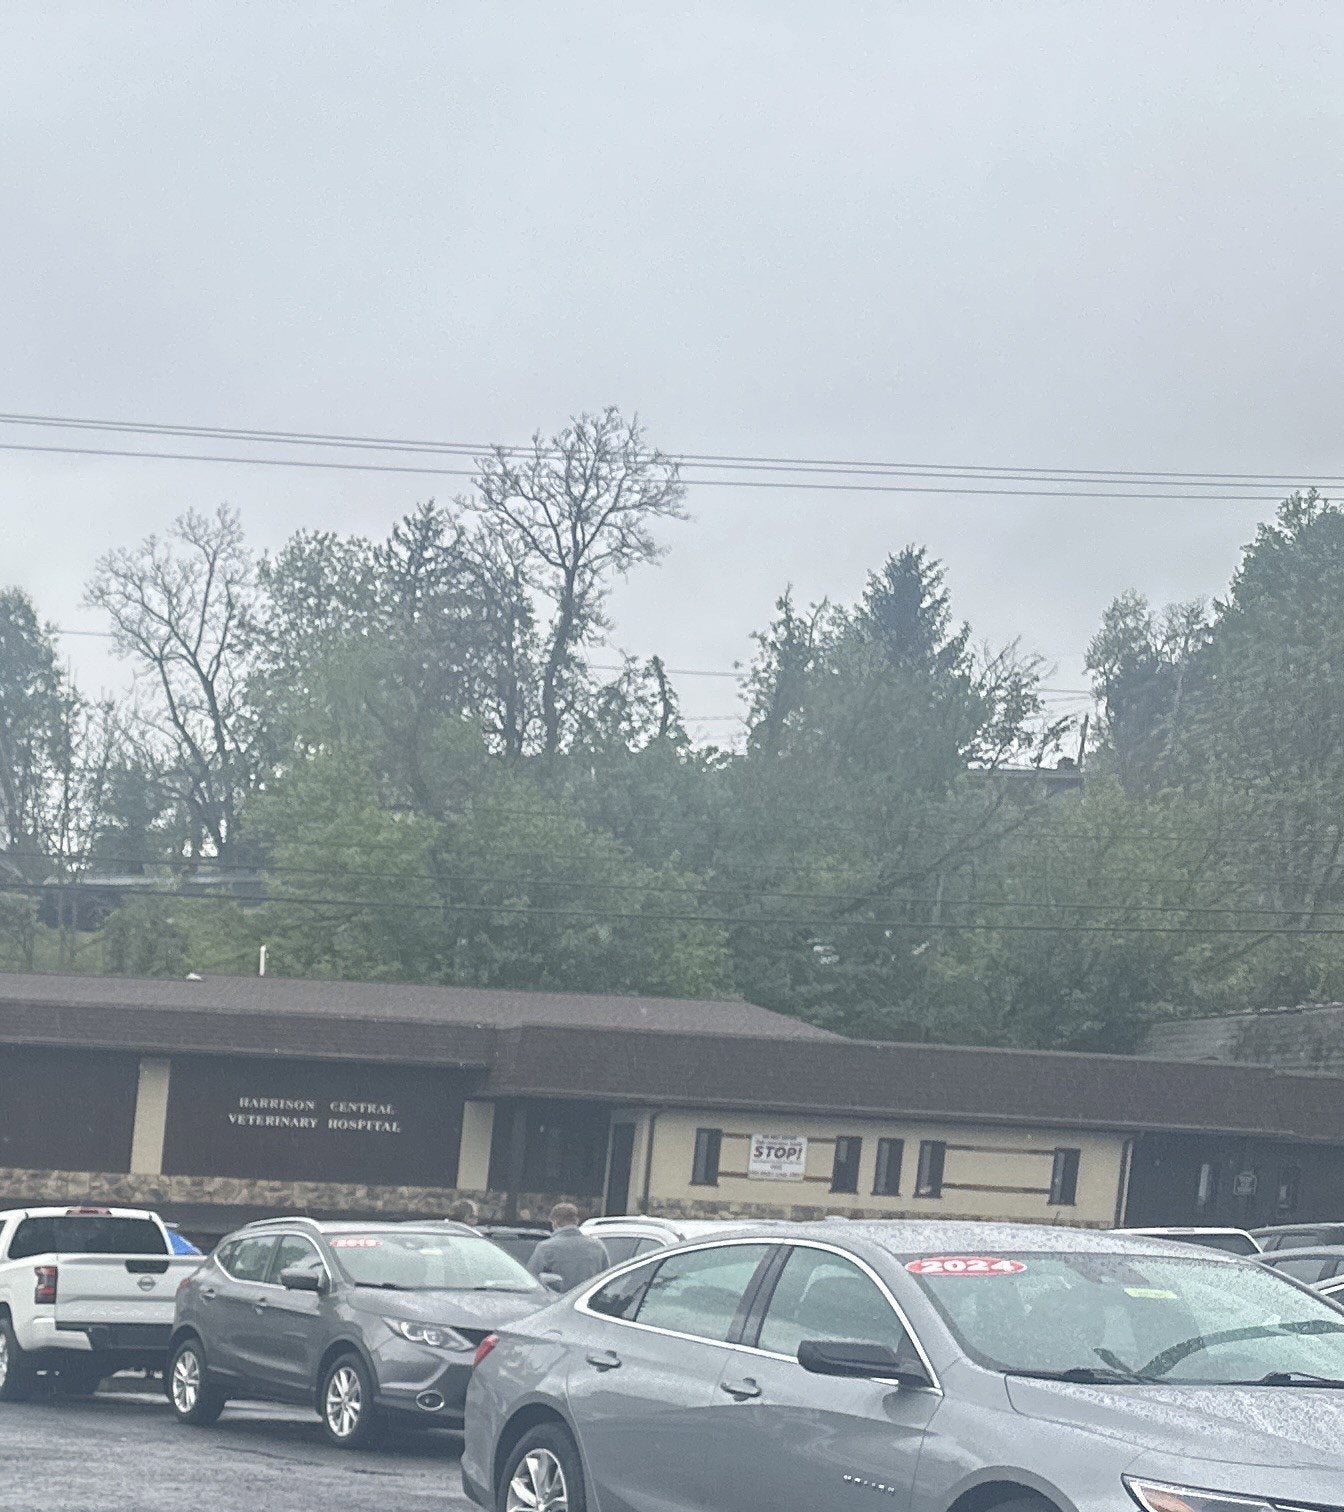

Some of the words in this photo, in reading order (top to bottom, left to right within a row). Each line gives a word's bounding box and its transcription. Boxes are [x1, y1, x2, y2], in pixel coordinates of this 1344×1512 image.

[239, 1097, 315, 1111] HARRISON
[329, 1101, 395, 1115] CENTRAL
[228, 1112, 318, 1129] VETERINARY
[327, 1118, 400, 1133] HOSPITAL
[753, 1145, 803, 1161] STOP!
[921, 1260, 1016, 1272] 2024
